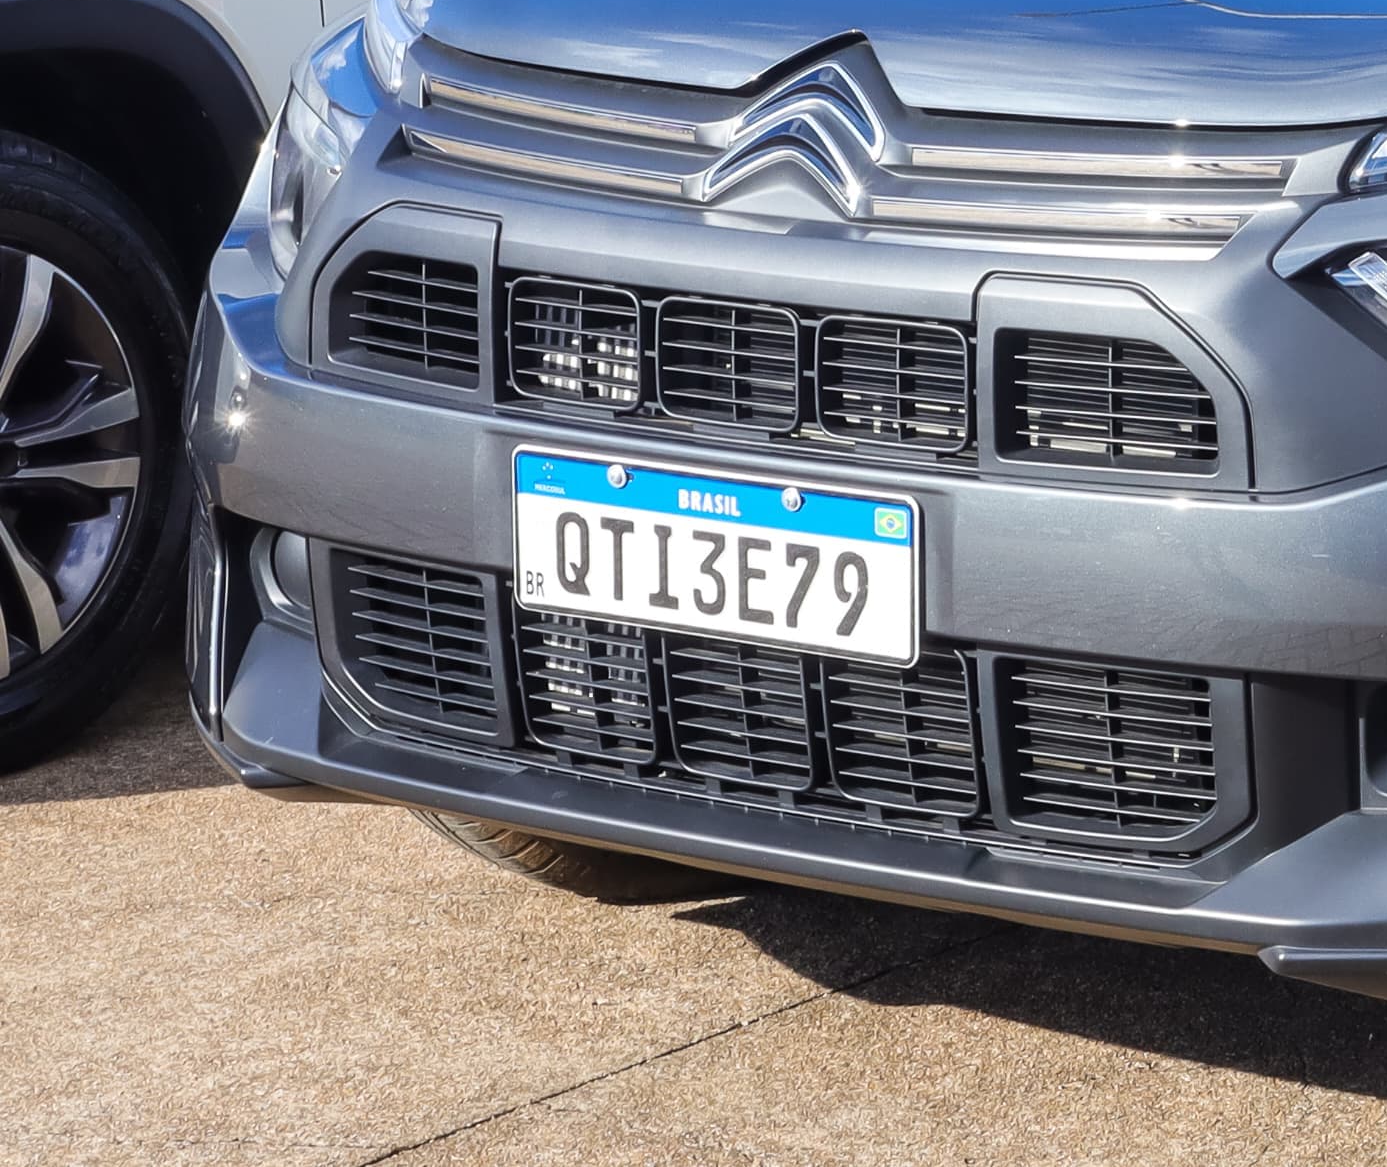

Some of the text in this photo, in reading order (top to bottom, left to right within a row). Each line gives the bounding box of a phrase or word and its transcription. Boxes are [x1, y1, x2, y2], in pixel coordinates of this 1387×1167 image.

[677, 488, 741, 517] BRASIL
[526, 570, 546, 598] BR
[555, 511, 869, 637] QTI3E79
